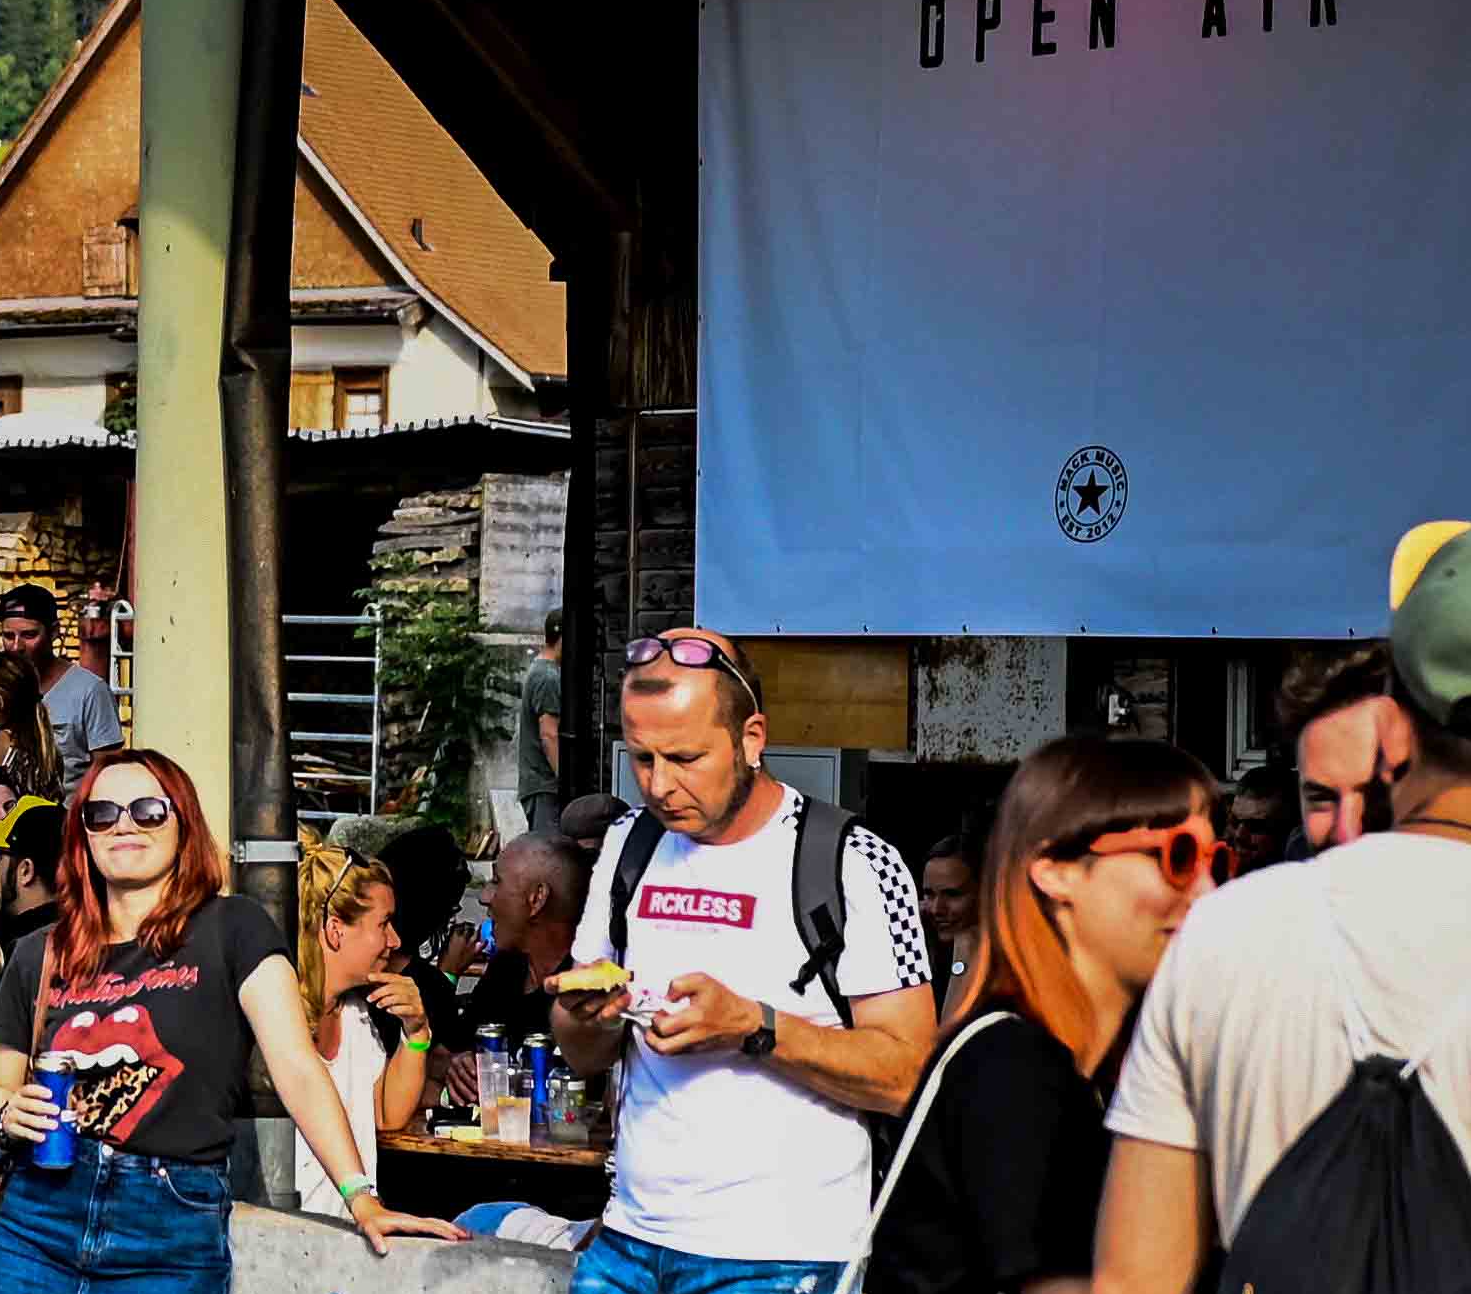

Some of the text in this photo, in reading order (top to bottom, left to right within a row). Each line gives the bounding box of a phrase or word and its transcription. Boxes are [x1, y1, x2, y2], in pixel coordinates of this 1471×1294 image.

[1060, 450, 1124, 491] MACK MUSIC
[1061, 513, 1116, 538] EST 2012
[648, 891, 743, 922] RCKLESS
